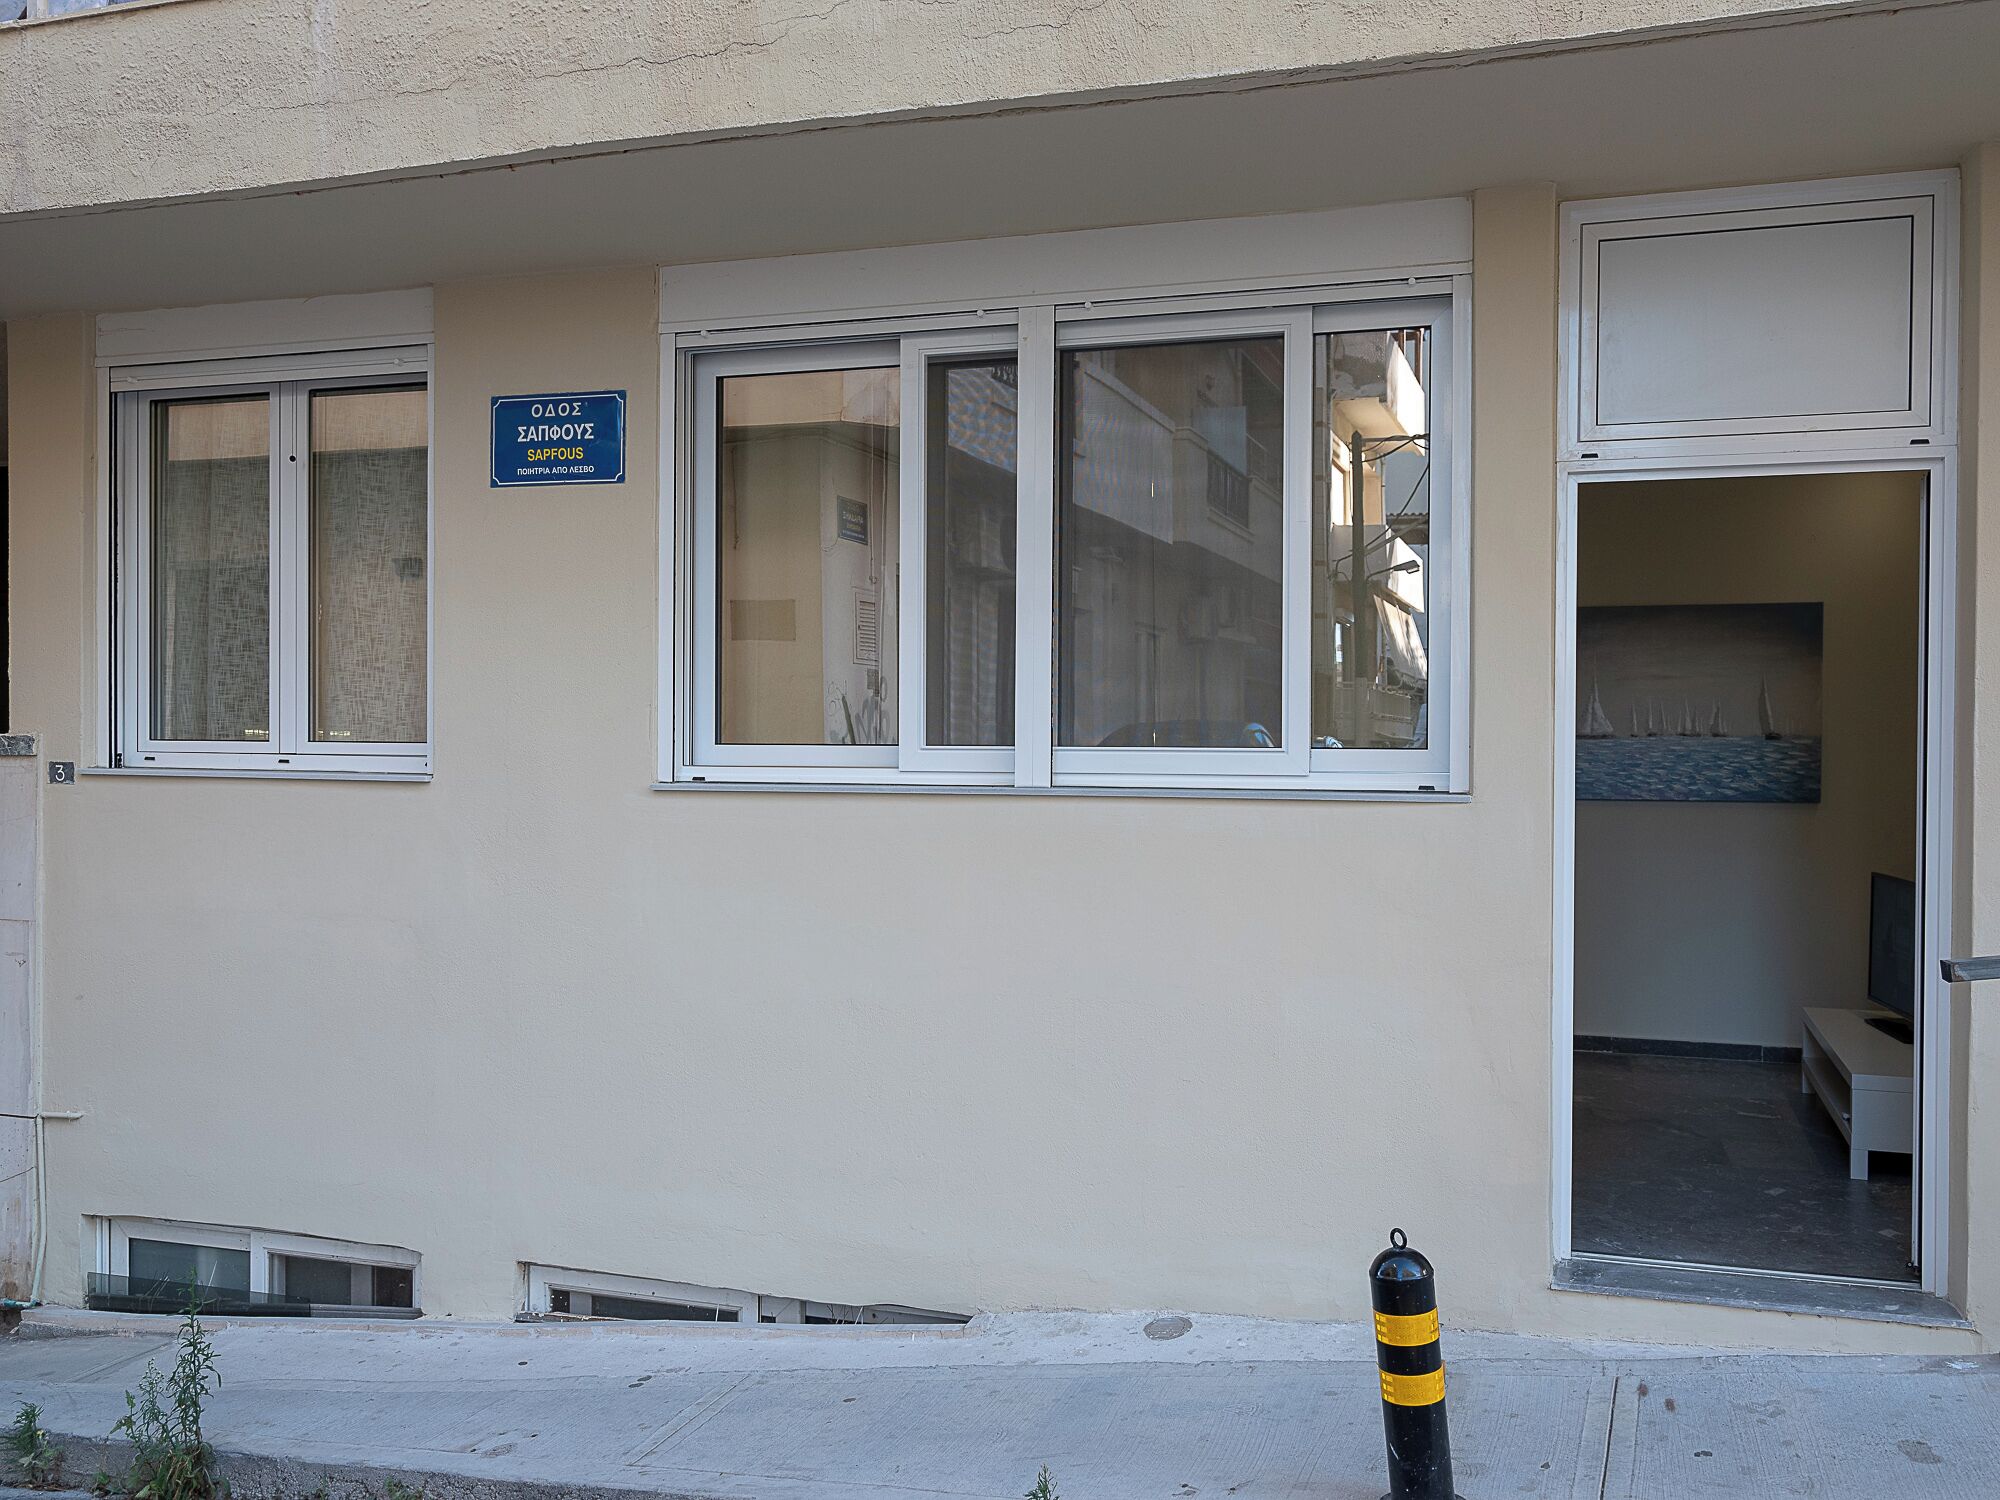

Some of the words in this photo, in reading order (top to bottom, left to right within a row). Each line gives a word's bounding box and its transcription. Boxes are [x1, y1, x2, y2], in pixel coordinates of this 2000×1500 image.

[531, 402, 581, 417] ΟΔΟΣ
[517, 423, 594, 442] ΣΑΠΦΟΥΣ
[527, 447, 584, 461] SAPFOUS
[517, 466, 551, 476] ΠΟΙΗΤΡΙΑ
[551, 466, 568, 475] ΑΠΟ
[569, 465, 595, 474] ΛΕΣΒΟ
[55, 765, 65, 781] 3
